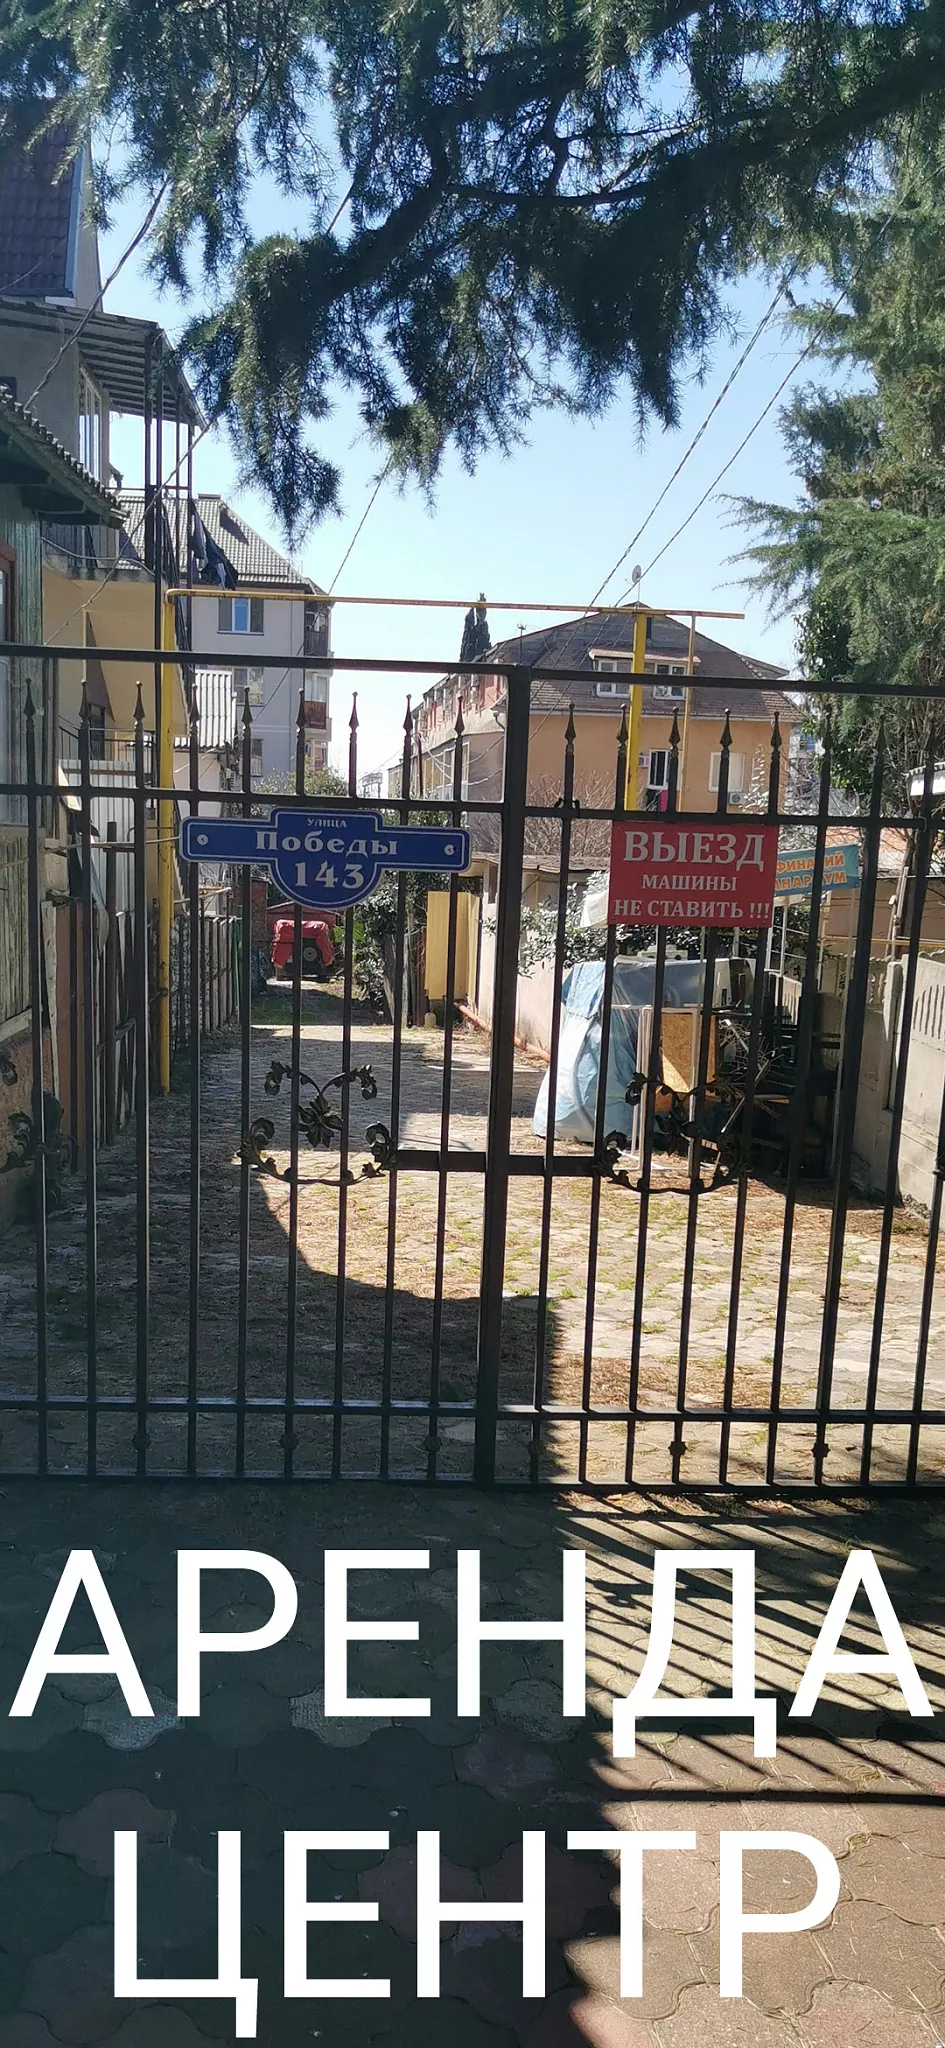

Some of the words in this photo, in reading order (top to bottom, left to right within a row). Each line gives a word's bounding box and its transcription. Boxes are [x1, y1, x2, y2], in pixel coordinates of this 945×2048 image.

[307, 818, 347, 828] УЛИЦА
[255, 830, 398, 858] Победы
[623, 831, 765, 872] ВЫЕЗД
[776, 851, 844, 873] ФИНАИЙ
[294, 860, 364, 889] 143
[642, 874, 738, 892] МАШИНЫ
[613, 899, 642, 916] НЕ
[647, 900, 744, 919] СТАВИТЬ
